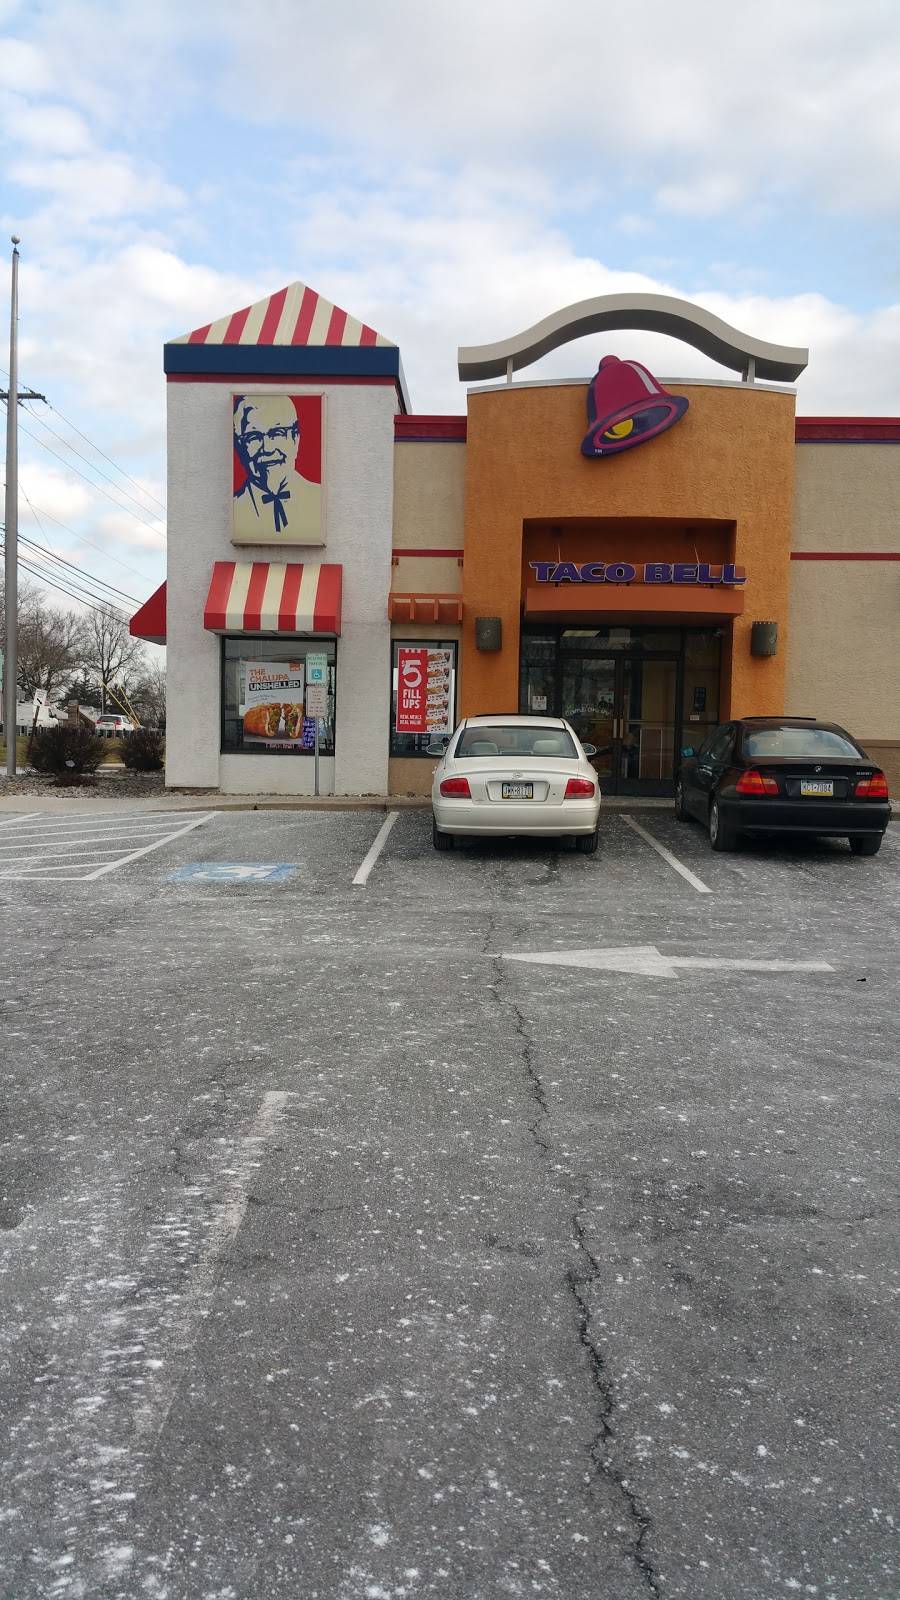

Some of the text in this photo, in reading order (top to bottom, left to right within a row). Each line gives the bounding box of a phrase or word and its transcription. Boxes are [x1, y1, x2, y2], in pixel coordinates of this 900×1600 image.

[529, 562, 749, 584] TACO BELL
[248, 668, 266, 676] THE
[249, 673, 289, 682] CHALUPA
[250, 680, 300, 690] UNSHELLED
[402, 688, 421, 699] FILL
[402, 699, 421, 709] UPS
